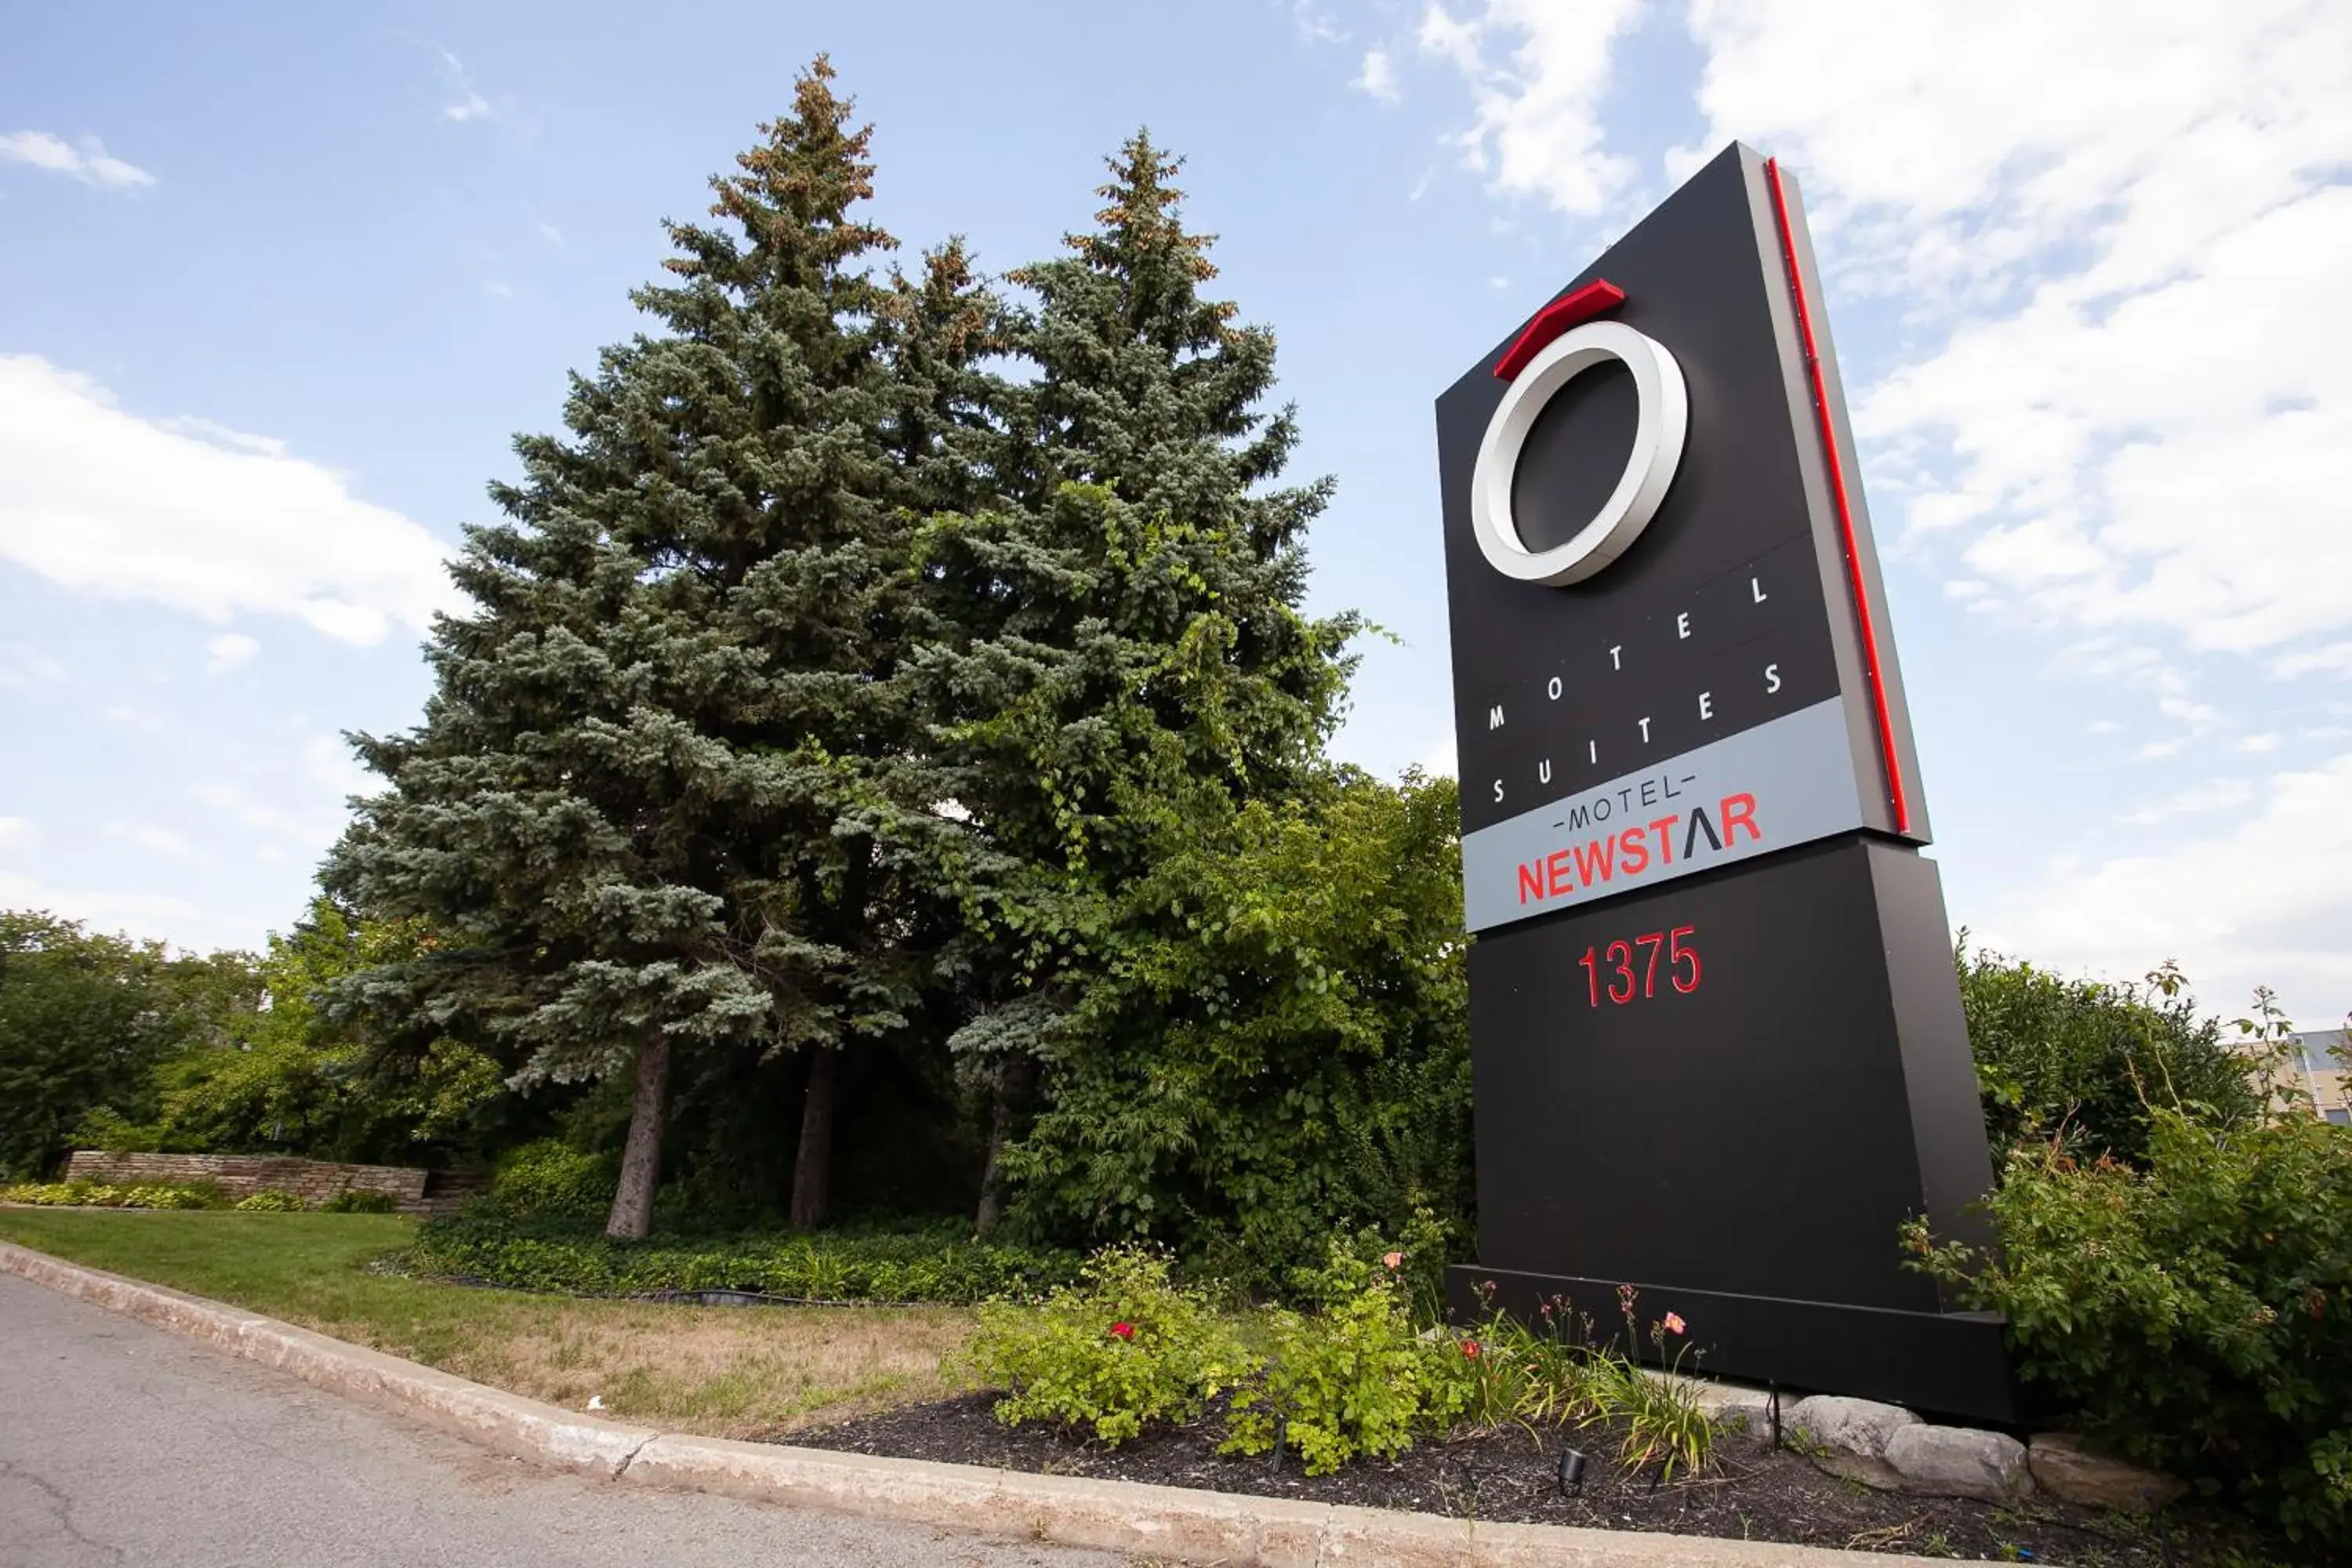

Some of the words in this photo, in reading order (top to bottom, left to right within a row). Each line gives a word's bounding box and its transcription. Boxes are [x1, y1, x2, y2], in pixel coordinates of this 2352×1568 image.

[1489, 577, 1767, 731] MOTEL
[1494, 664, 1781, 802] SUITES
[1579, 925, 1701, 1007] 1375
